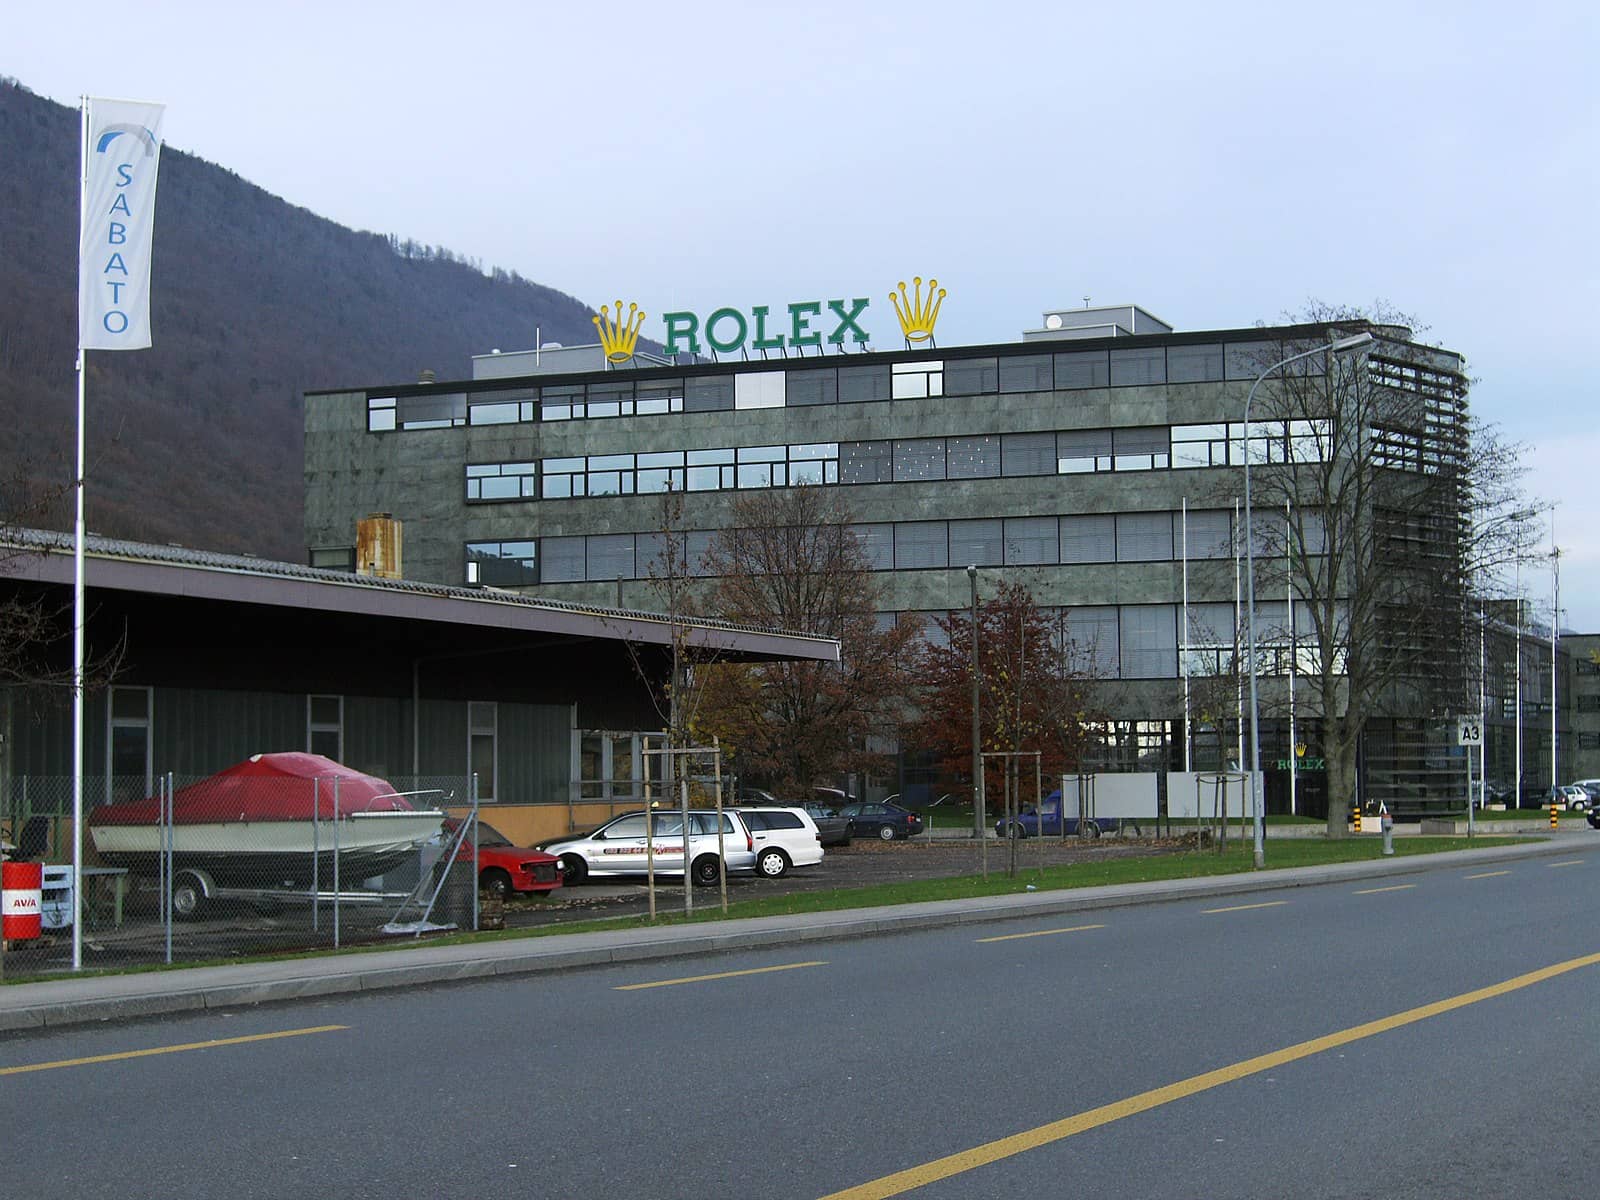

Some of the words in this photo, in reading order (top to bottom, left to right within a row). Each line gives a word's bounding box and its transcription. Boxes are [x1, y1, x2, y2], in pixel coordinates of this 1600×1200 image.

[103, 163, 133, 334] SABATO
[662, 298, 870, 355] ROLEX
[1463, 726, 1480, 741] A3
[14, 898, 36, 907] AVIA
